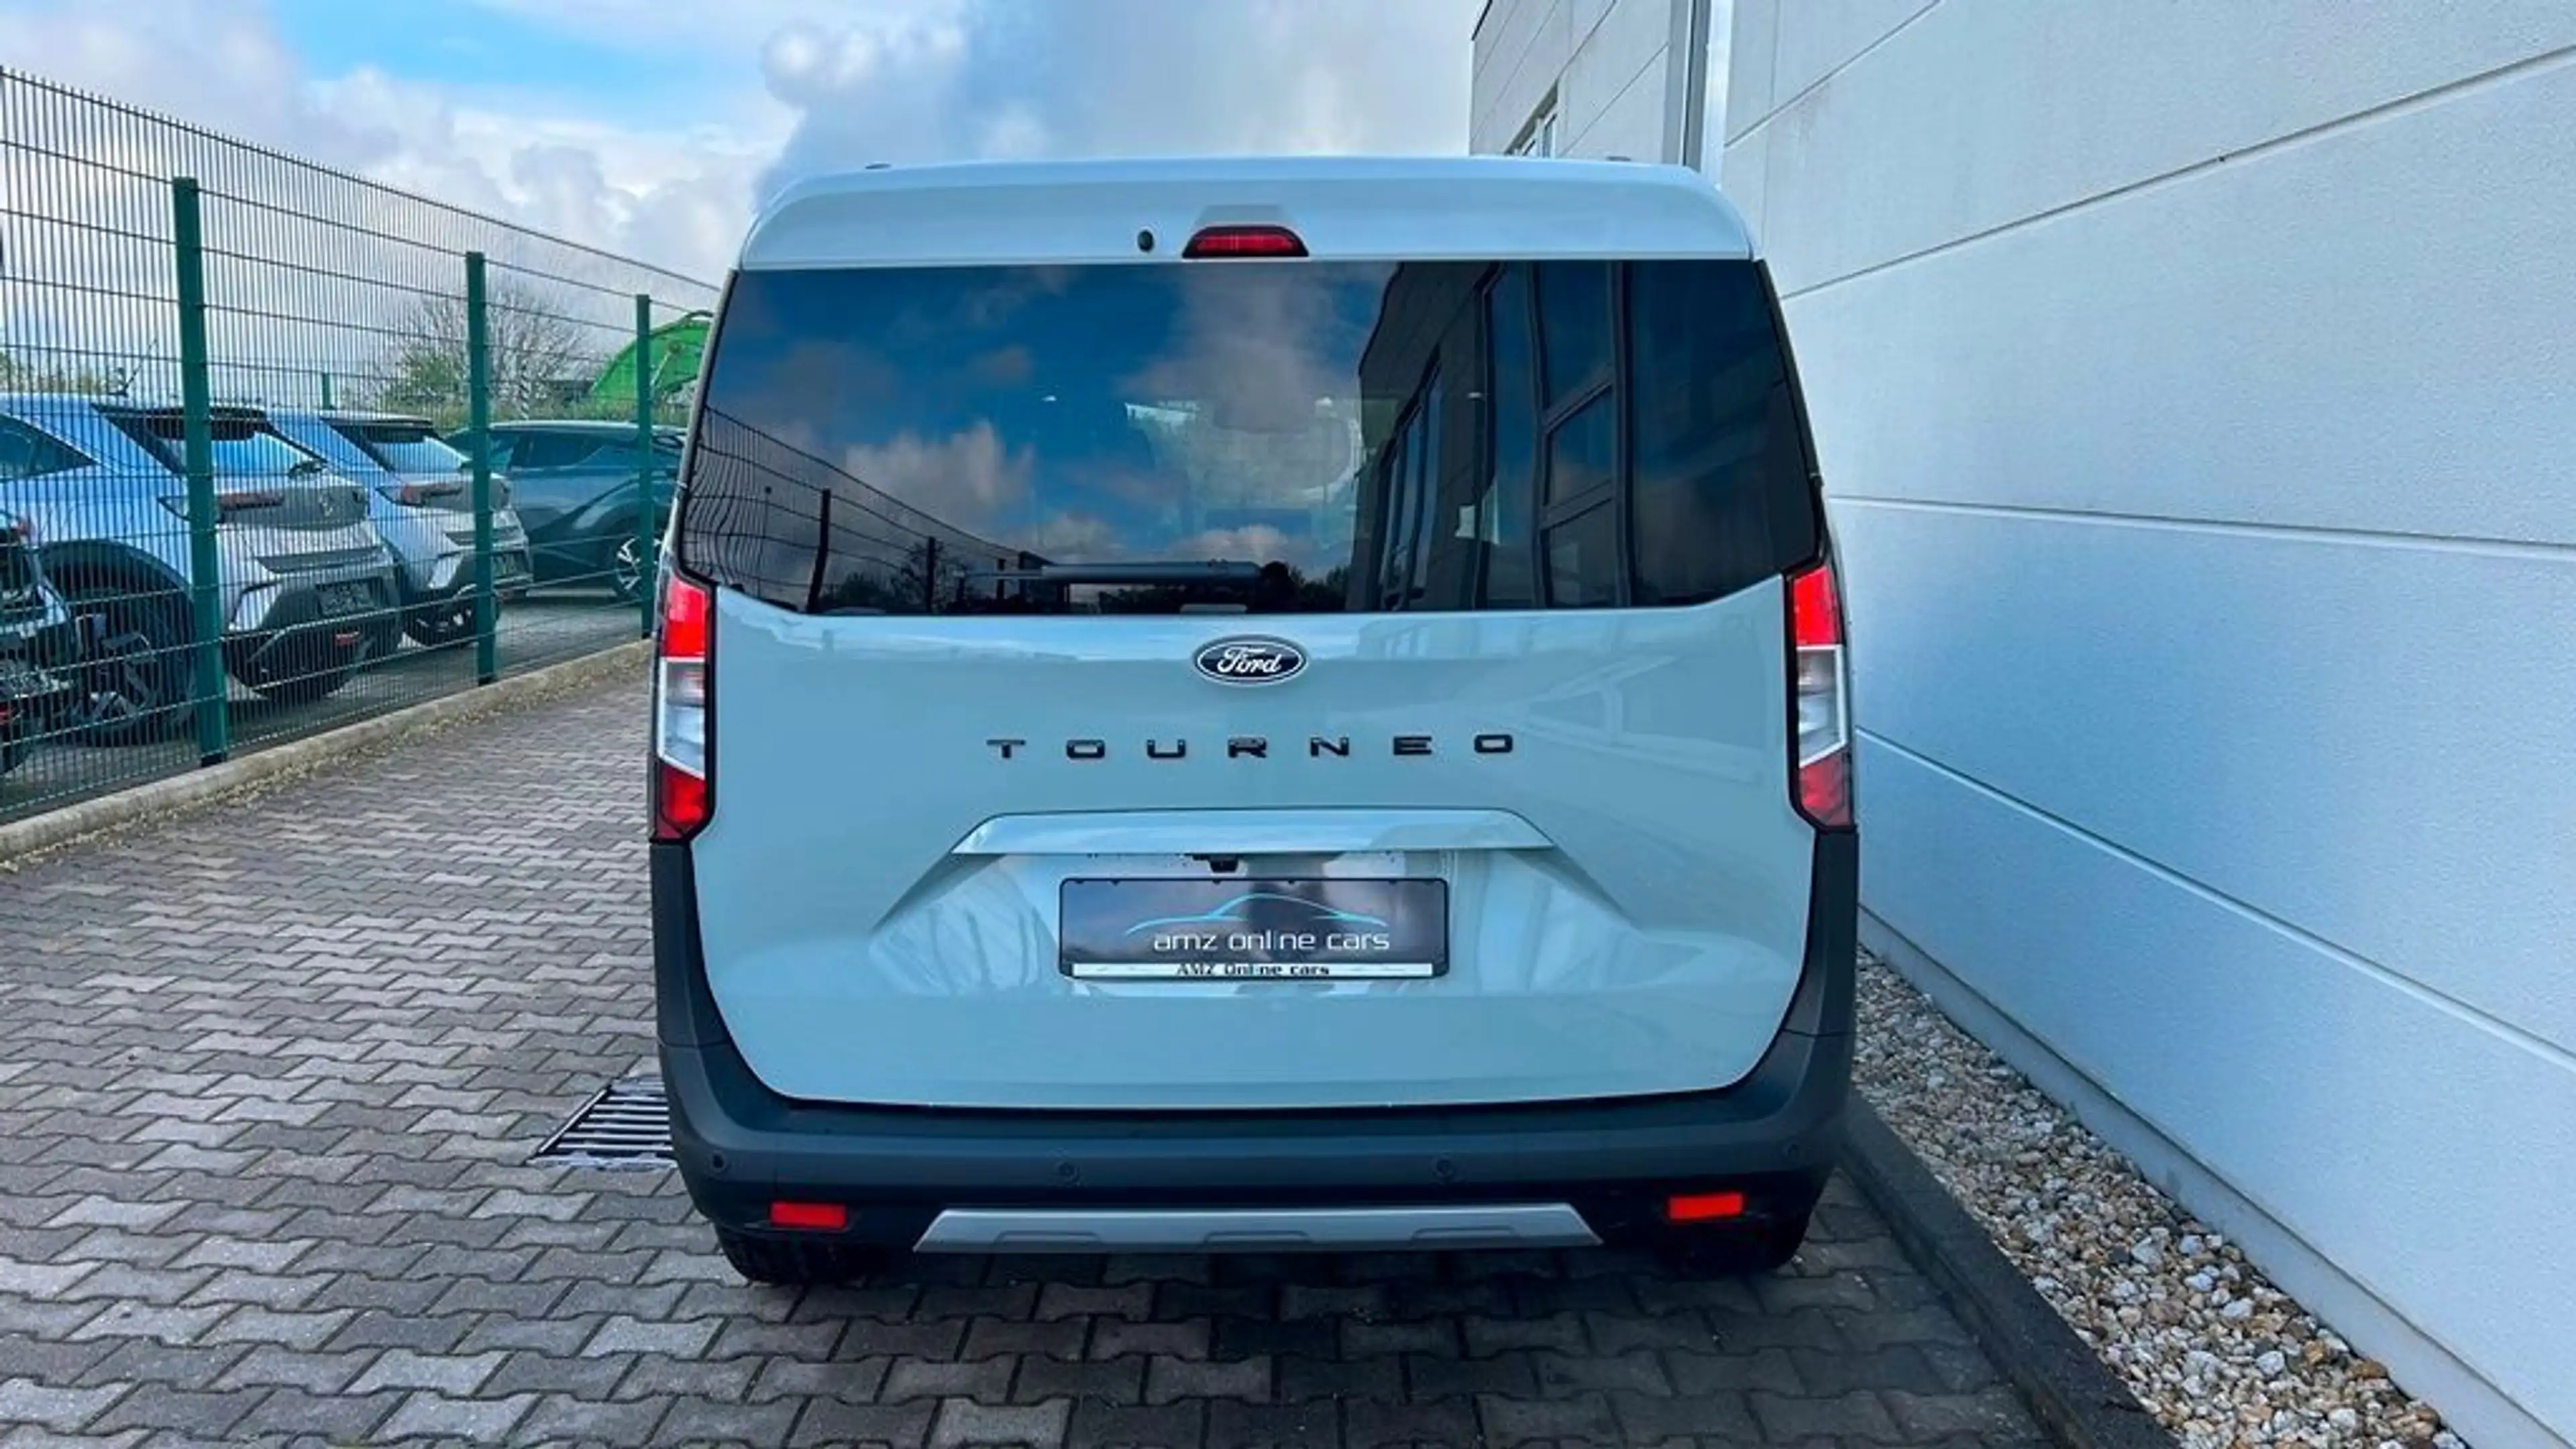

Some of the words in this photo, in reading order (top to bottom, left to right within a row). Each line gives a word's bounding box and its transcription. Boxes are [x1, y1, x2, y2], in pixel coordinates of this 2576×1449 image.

[1217, 646, 1282, 674] Ford
[987, 735, 1514, 759] TOURNEO
[1154, 932, 1218, 951] amz
[1229, 930, 1316, 951] online
[1327, 932, 1390, 951] cars
[1176, 963, 1214, 975] AMZ
[1289, 965, 1330, 975] cars
